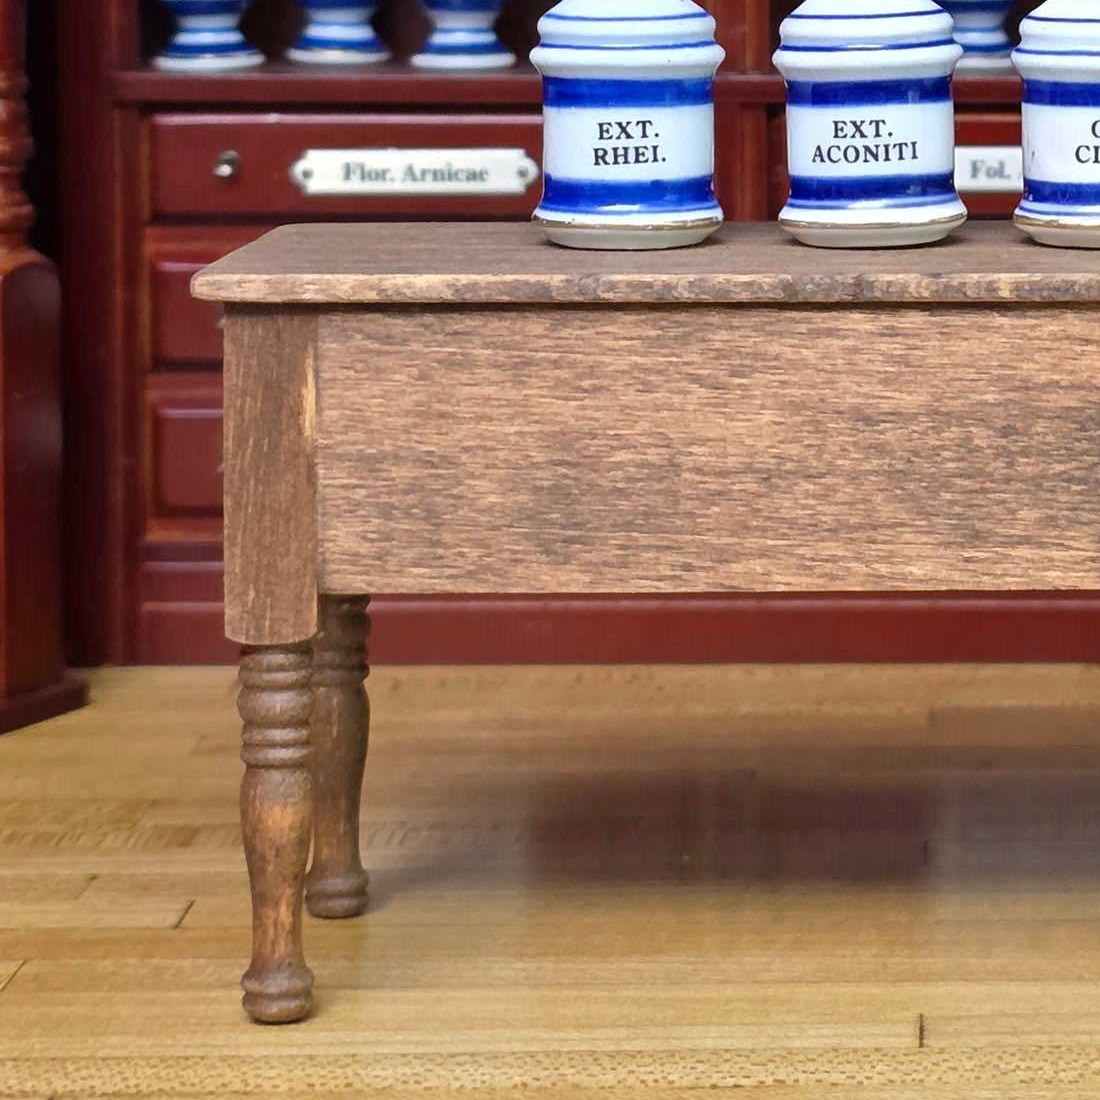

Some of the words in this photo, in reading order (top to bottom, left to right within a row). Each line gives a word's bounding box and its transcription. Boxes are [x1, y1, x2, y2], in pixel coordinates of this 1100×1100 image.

[597, 120, 660, 141] EXT.
[832, 119, 893, 139] EXT.
[592, 144, 667, 166] RHEI.
[811, 141, 919, 164] ACONITI
[341, 158, 396, 183] Flor.
[969, 159, 1012, 181] Fol.
